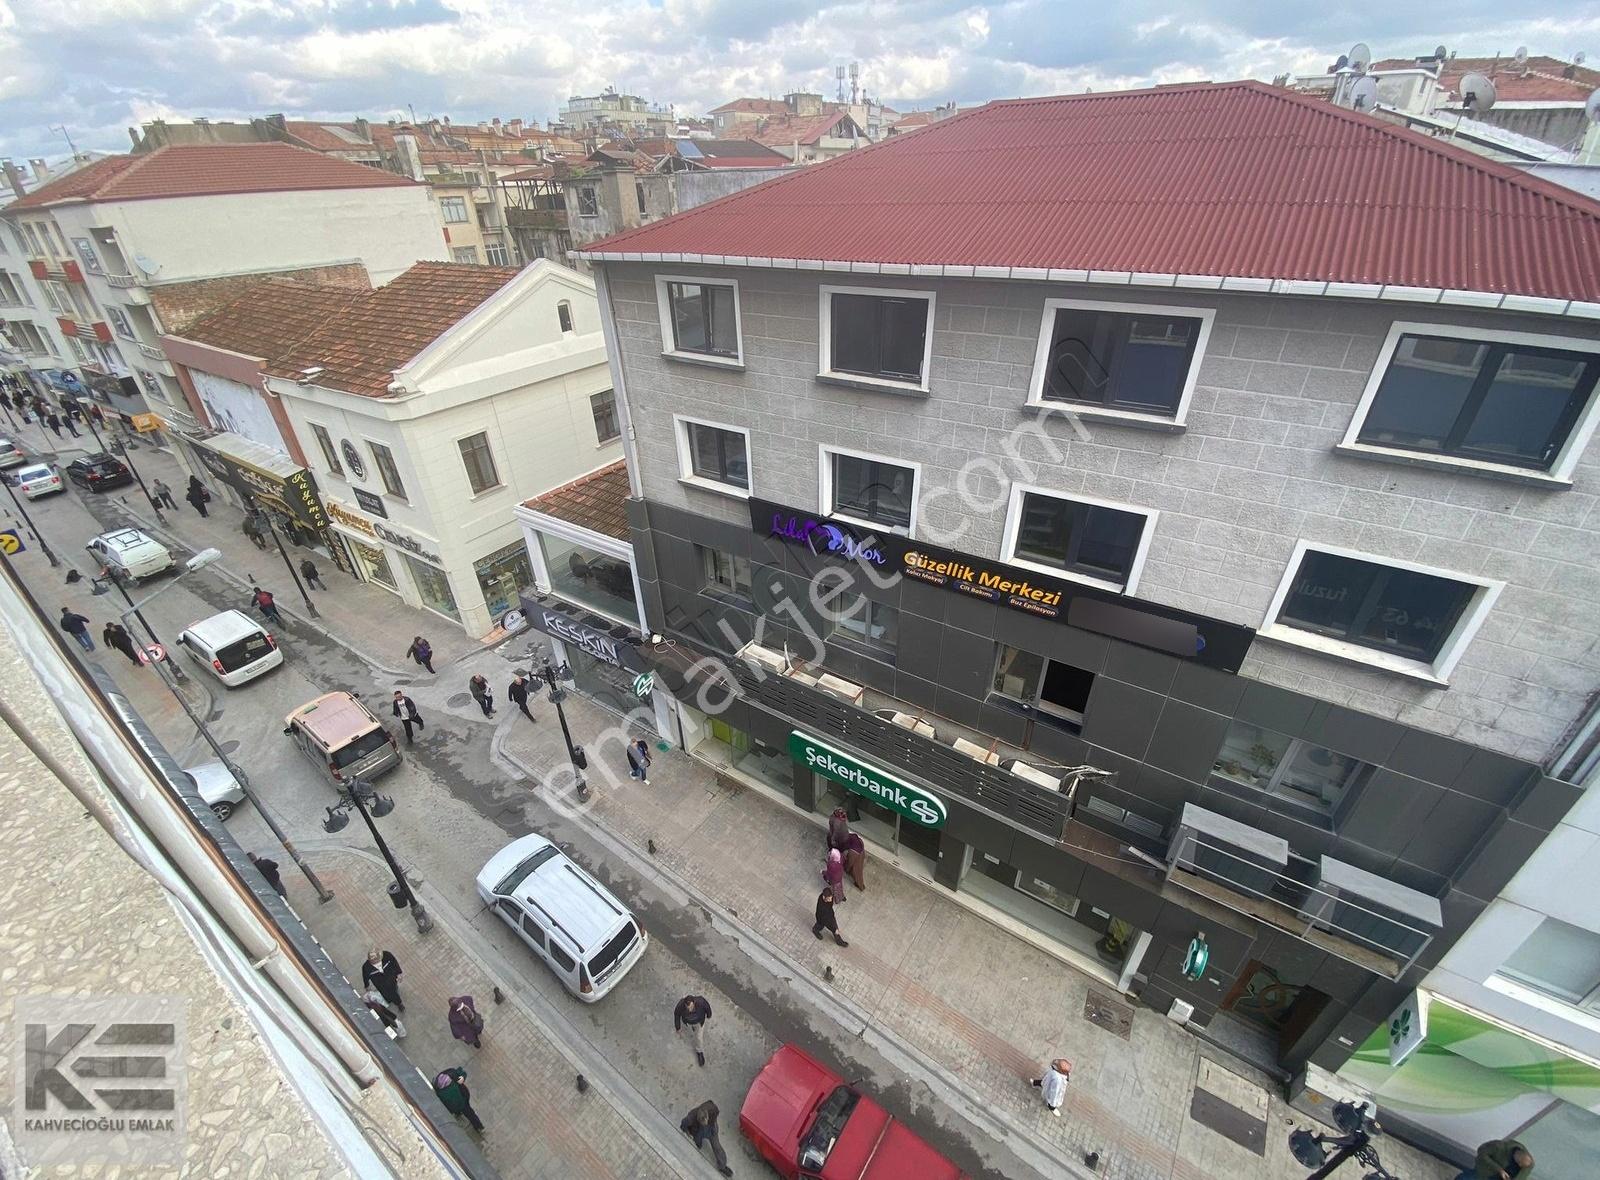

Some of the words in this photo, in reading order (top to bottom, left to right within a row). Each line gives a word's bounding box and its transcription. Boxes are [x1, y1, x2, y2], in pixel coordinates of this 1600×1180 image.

[291, 472, 326, 528] Kuyumcu
[841, 533, 886, 565] Mor
[903, 550, 976, 583] Güzellik
[978, 571, 1063, 606] Merkezi
[1010, 598, 1023, 607] Buz
[1023, 601, 1057, 617] Epilasyon
[804, 746, 908, 809] Şekerbank
